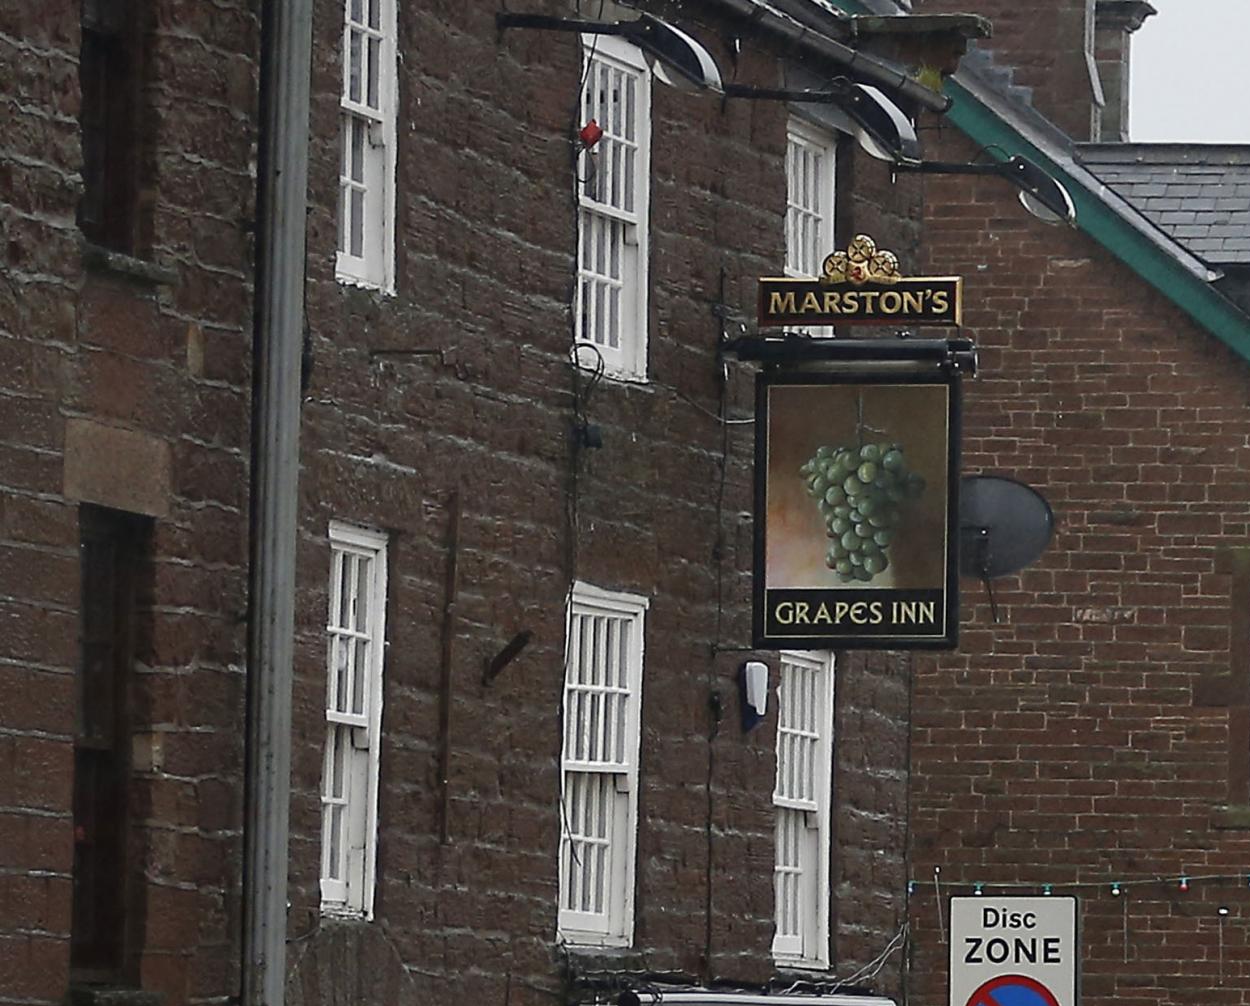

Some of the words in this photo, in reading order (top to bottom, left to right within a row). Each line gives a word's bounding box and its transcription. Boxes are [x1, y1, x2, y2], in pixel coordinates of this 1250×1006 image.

[768, 289, 948, 314] MARSTON'S
[775, 601, 883, 624] GRAPES
[891, 601, 935, 624] INN
[983, 908, 1037, 929] Disc
[964, 937, 1061, 964] ZONE
